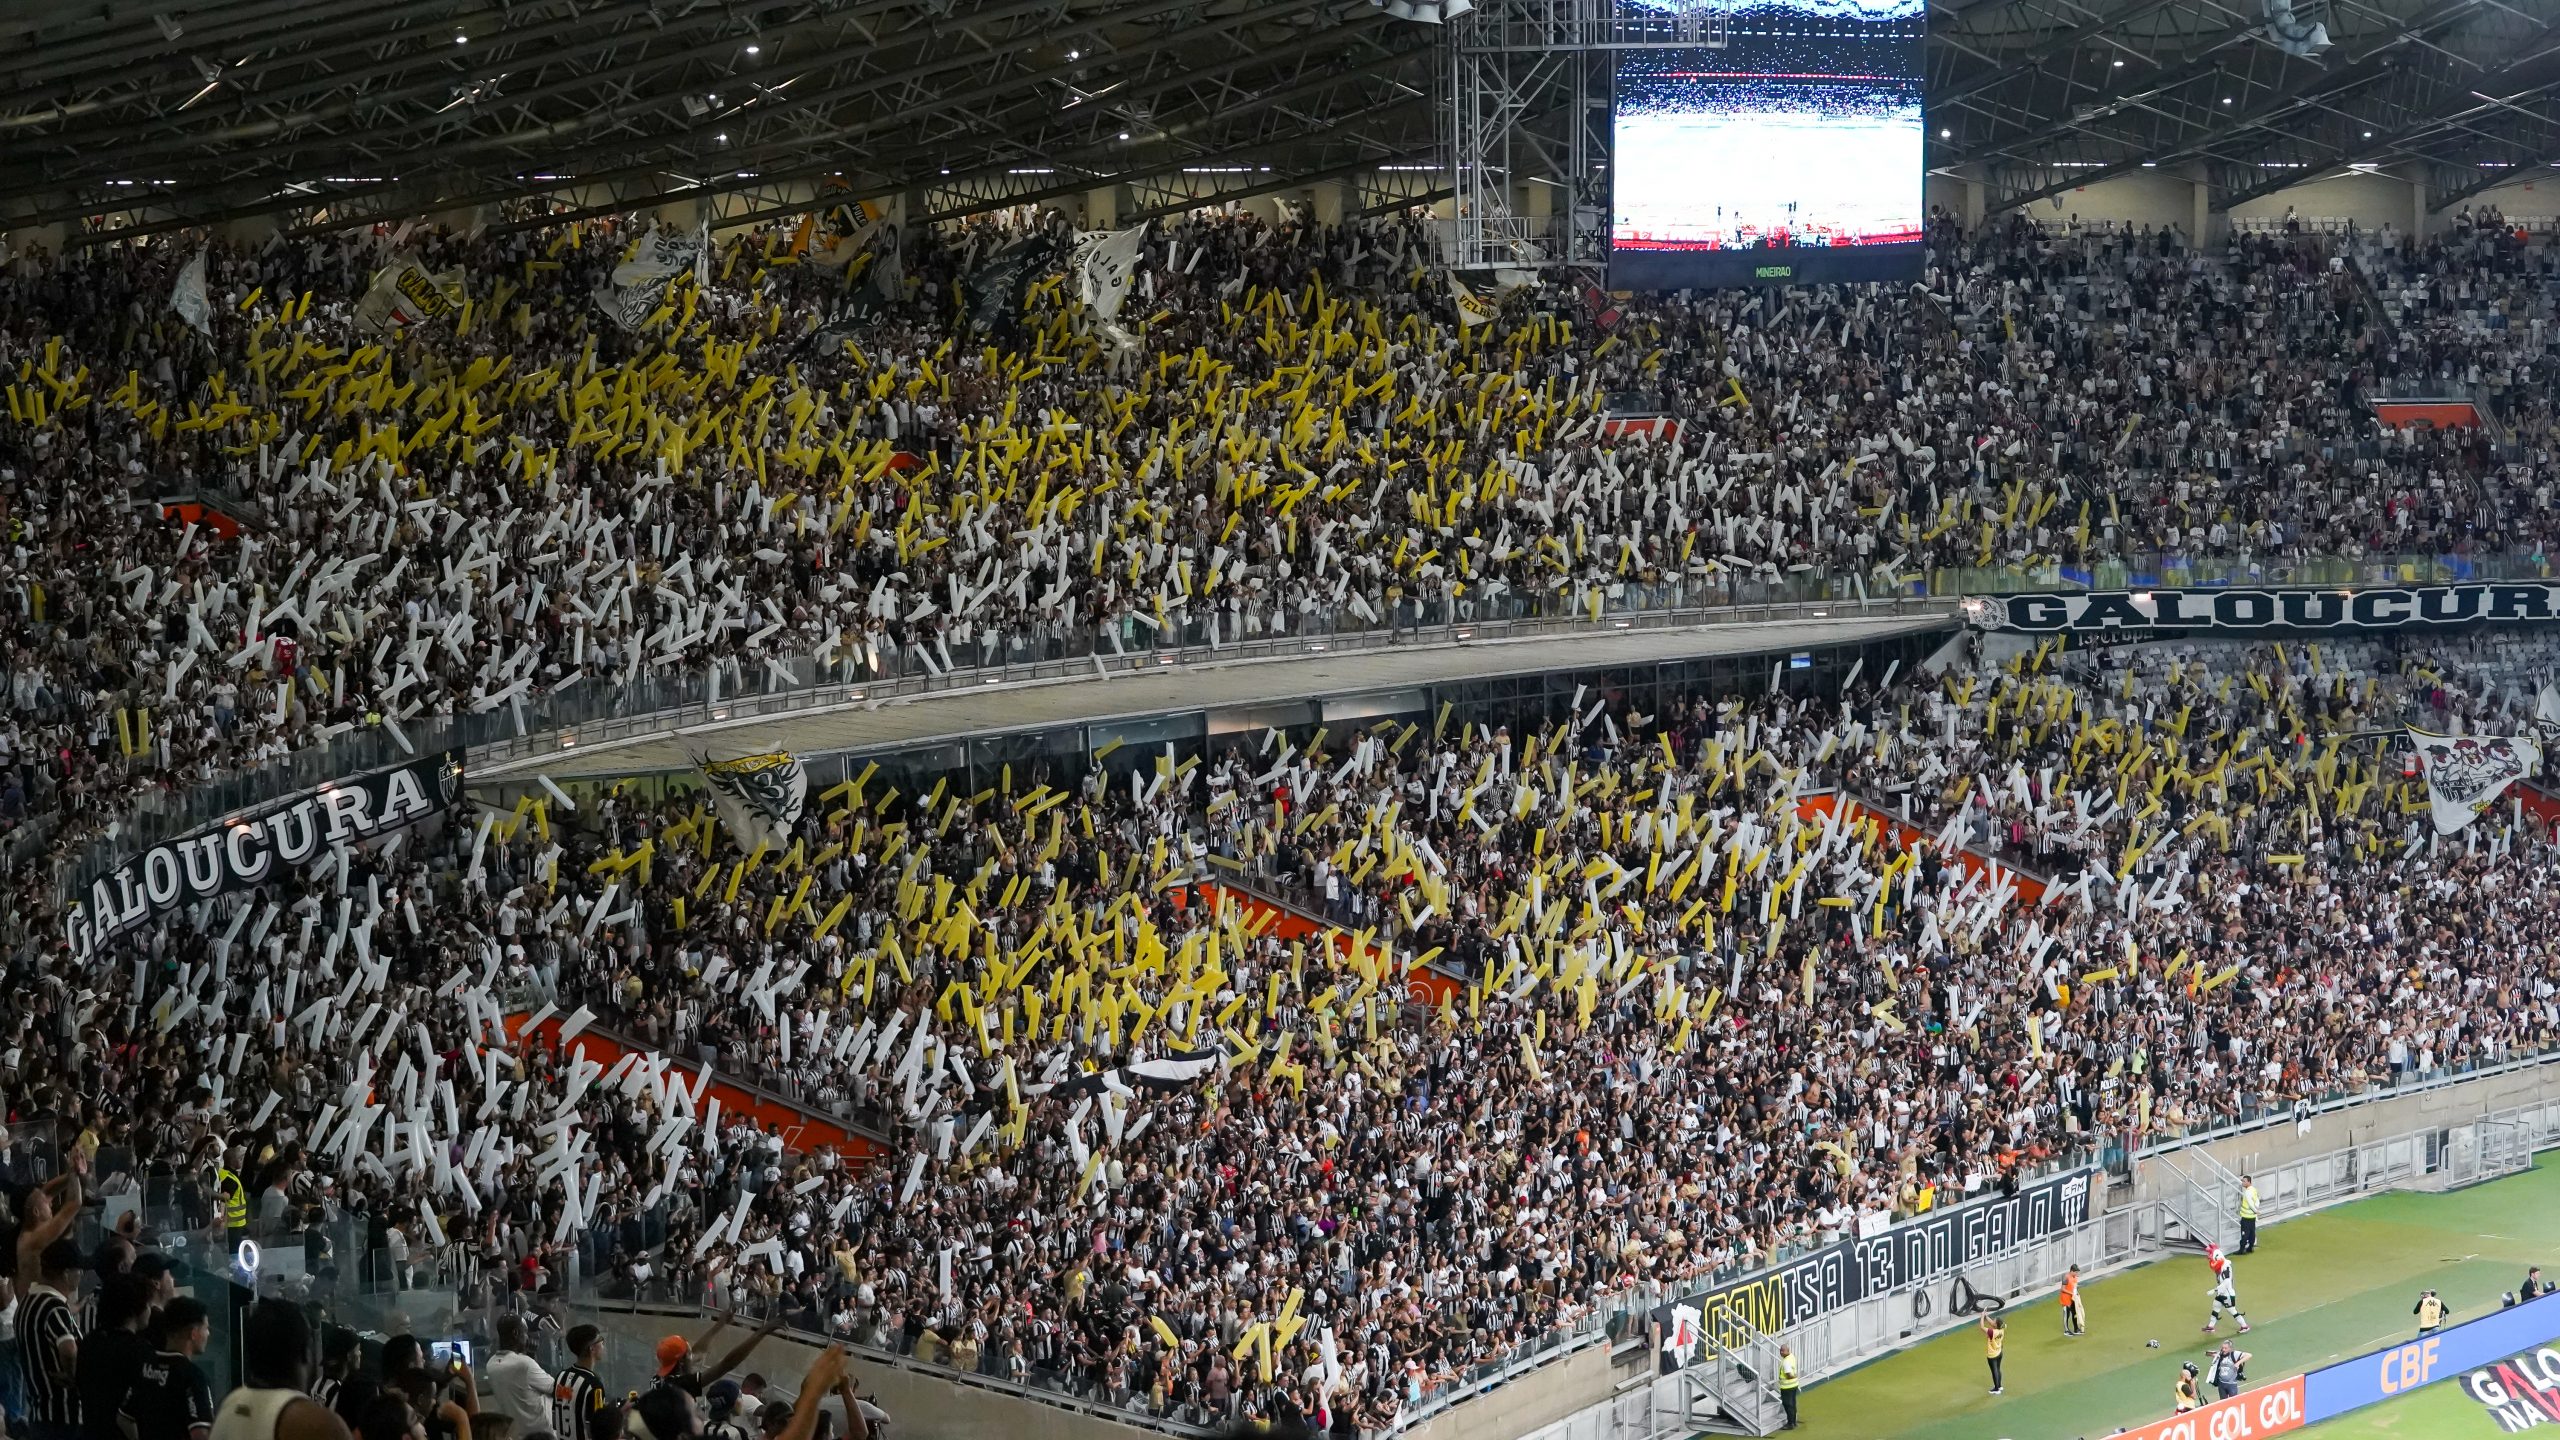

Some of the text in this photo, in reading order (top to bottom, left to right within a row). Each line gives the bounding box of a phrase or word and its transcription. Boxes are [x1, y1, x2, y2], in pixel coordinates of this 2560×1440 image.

[828, 303, 882, 326] GALO
[2006, 583, 2560, 627] GALOUCUR
[67, 768, 431, 968] GALOUCURA
[2064, 1180, 2085, 1197] CAM
[1704, 1187, 2053, 1361] CAMISA 13 DO GALO
[2380, 1337, 2441, 1394] CBF
[2471, 1348, 2560, 1406] GALO
[2210, 1403, 2251, 1440] GOL
[2260, 1387, 2301, 1429] GOL
[2498, 1399, 2549, 1433] NA
